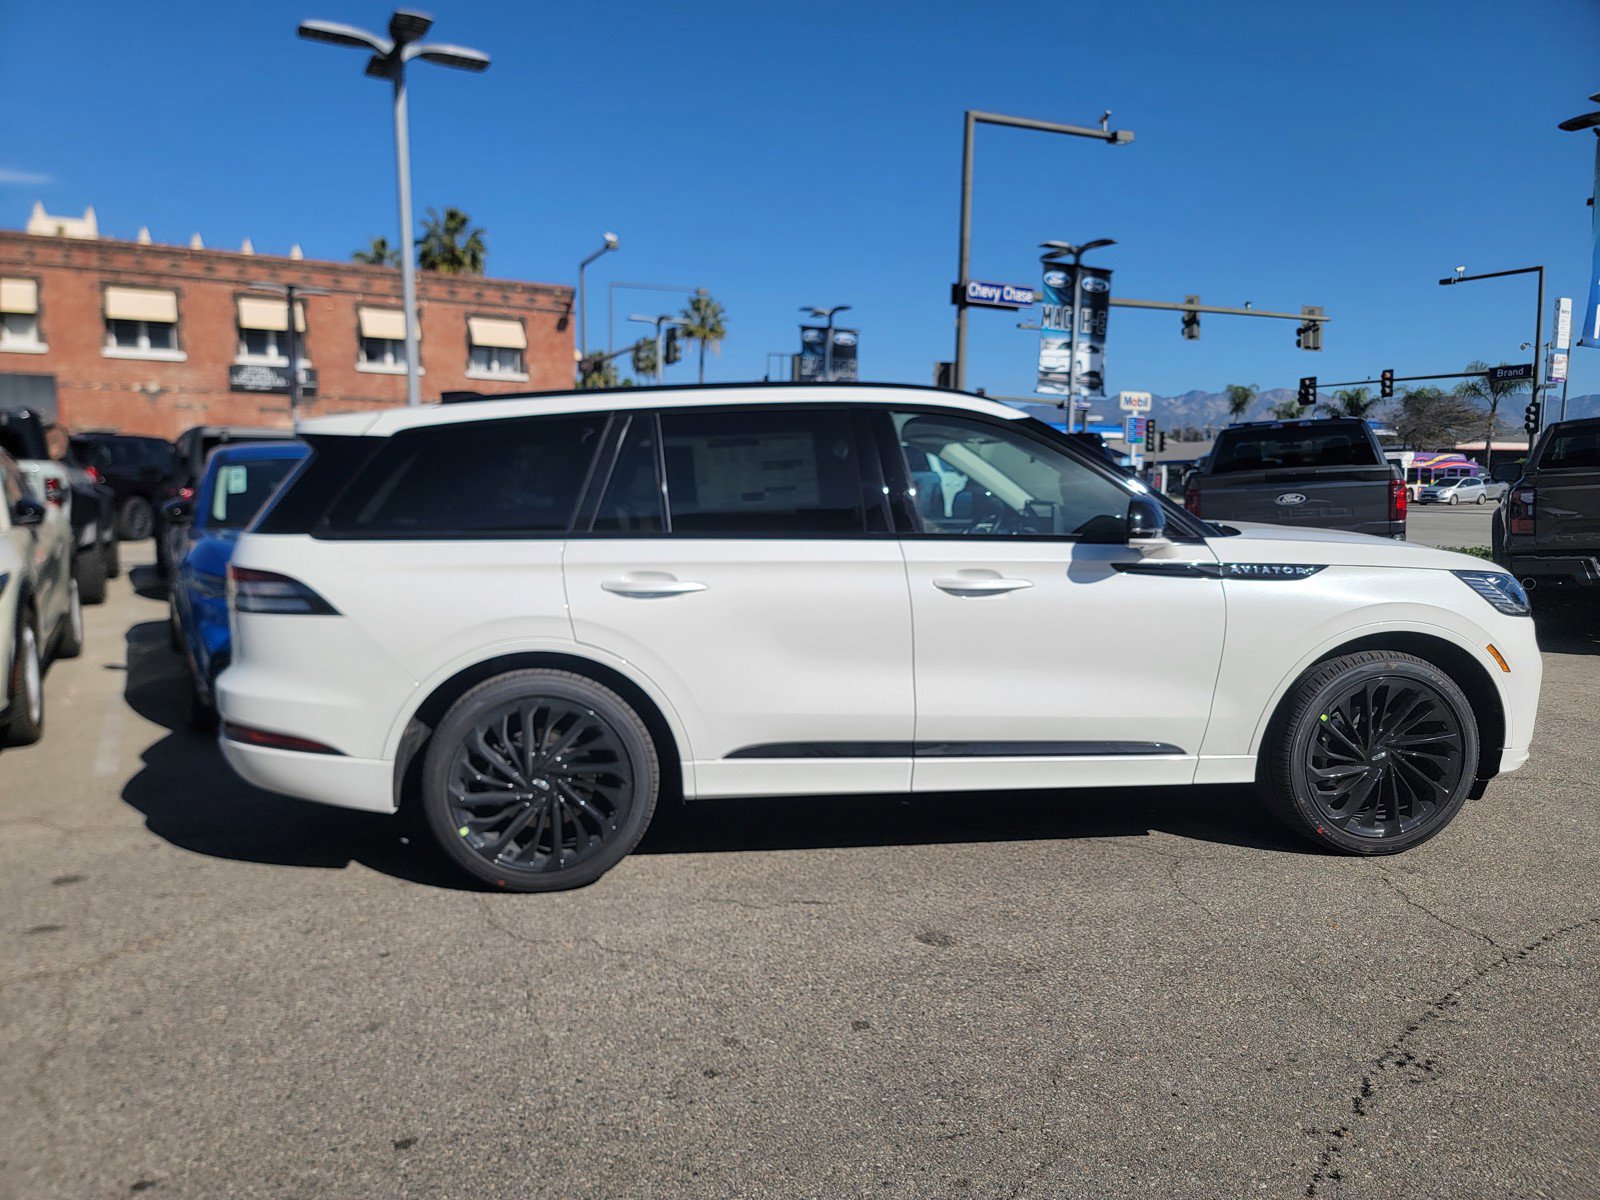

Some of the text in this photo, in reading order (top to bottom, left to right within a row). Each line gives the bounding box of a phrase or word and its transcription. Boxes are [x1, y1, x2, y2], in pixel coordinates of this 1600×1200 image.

[968, 282, 1033, 303] Chevy Chase
[1496, 366, 1525, 378] Brand
[1123, 396, 1148, 408] Mobil
[1230, 563, 1307, 576] AVIATOR
